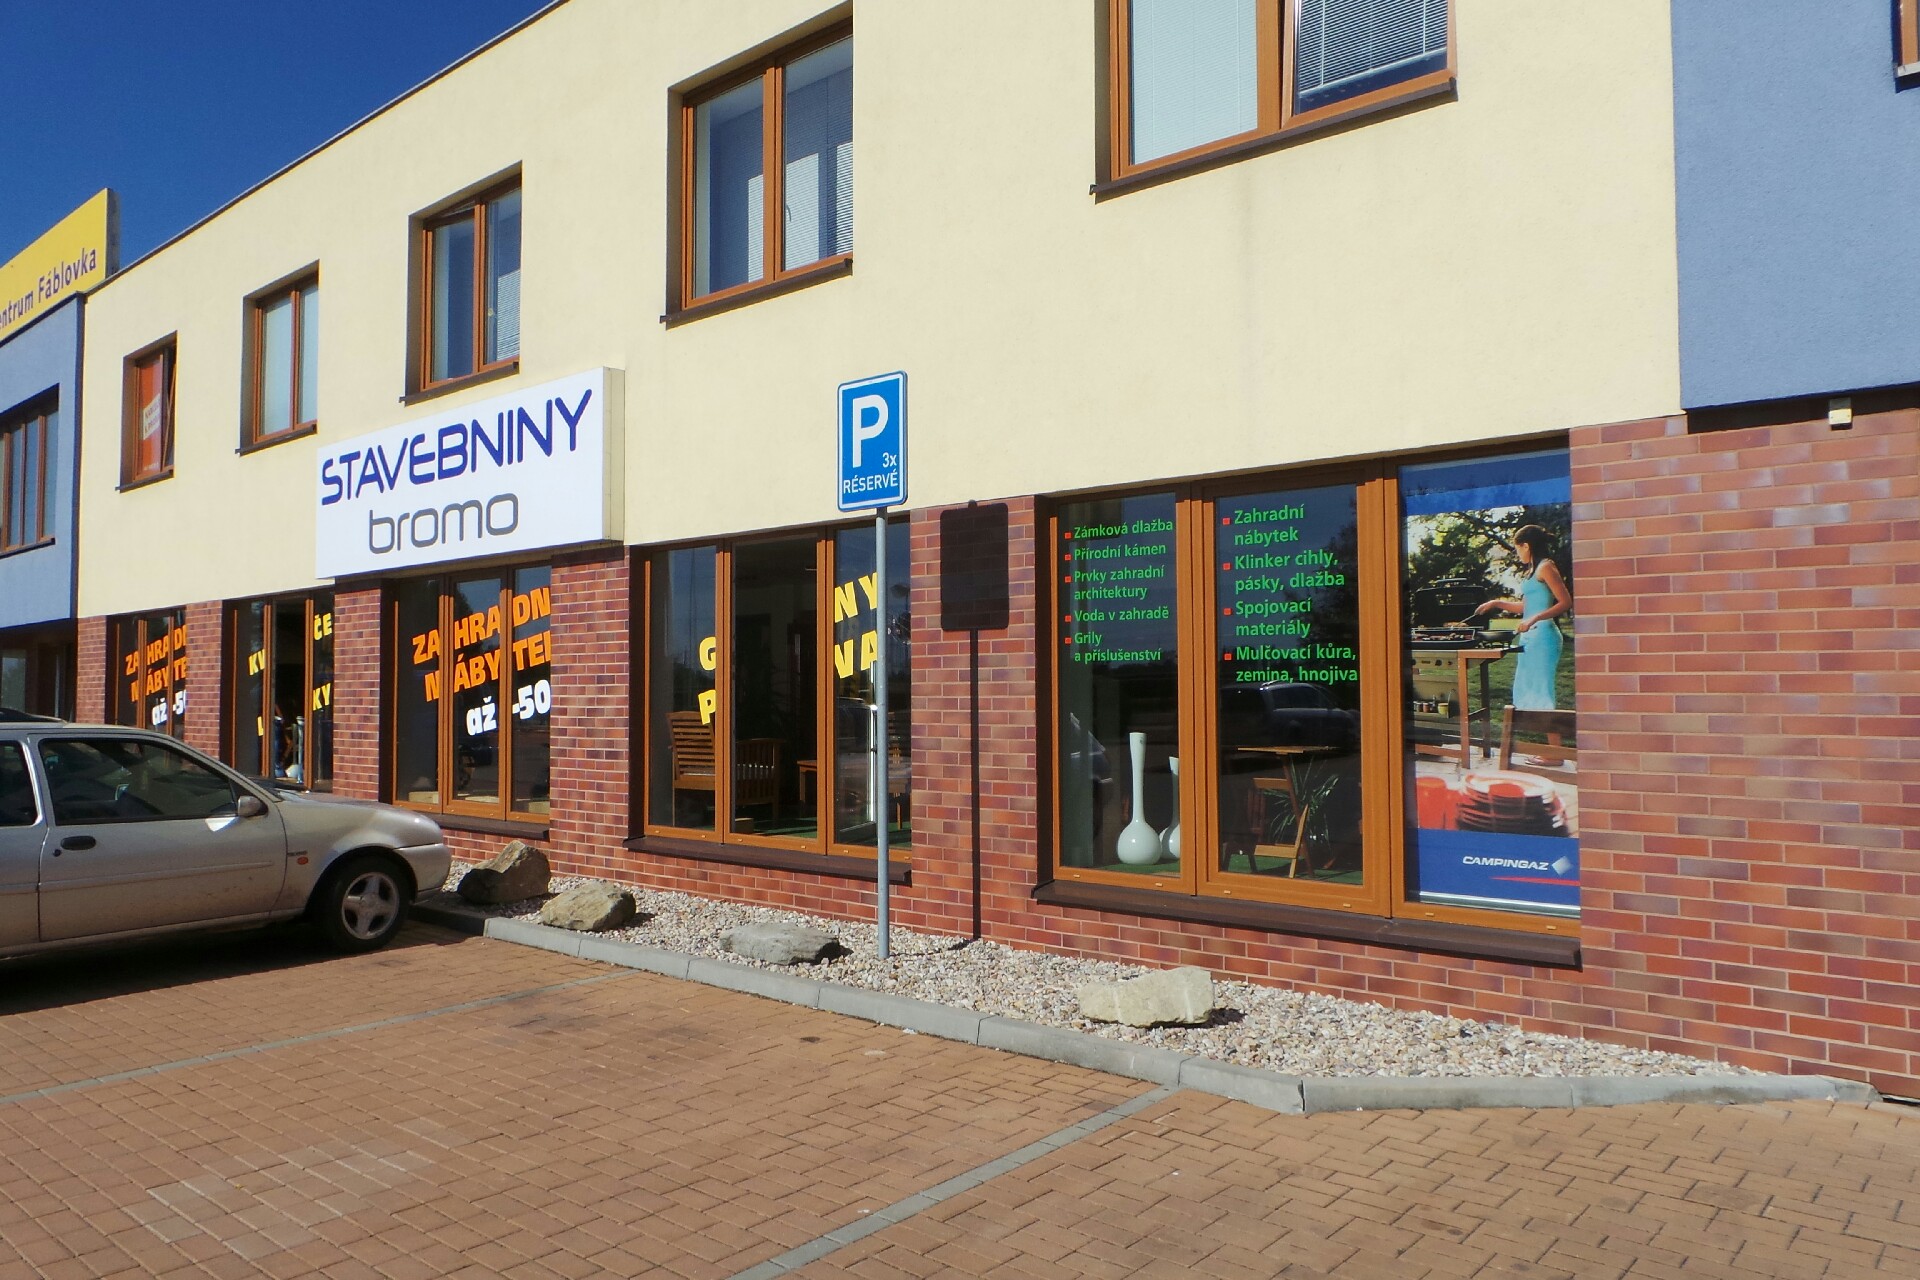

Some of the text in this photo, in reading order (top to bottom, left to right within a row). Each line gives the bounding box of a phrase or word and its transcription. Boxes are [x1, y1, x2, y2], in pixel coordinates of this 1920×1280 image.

[38, 247, 96, 304] Fáblovka
[852, 394, 889, 468] P
[321, 388, 593, 506] STAVEBNINY
[882, 452, 897, 468] 3x
[843, 469, 899, 494] RÉSERVÉ
[368, 492, 519, 555] bromo
[1234, 504, 1305, 525] Zahradní
[1074, 518, 1174, 539] Zámková dlažba
[1234, 527, 1299, 547] nábytek
[1074, 543, 1166, 561] Přírodní kámen
[1235, 549, 1339, 570] Klinker cihly,
[1074, 564, 1165, 584] Prvky zahradní
[1235, 571, 1345, 595] pásky, dlažba
[1074, 585, 1148, 601] architektury
[1074, 605, 1170, 622] Voda v zahradě
[1235, 597, 1312, 619] Spojovací
[1074, 631, 1103, 647] Grily
[1236, 620, 1311, 639] materiály
[1074, 648, 1162, 664] a příslušenství
[1236, 642, 1357, 661] Mulčovací kůra,
[1236, 666, 1358, 686] zemina, hnojiva
[466, 695, 497, 736] až
[1462, 855, 1549, 871] CAMPINGAZ
